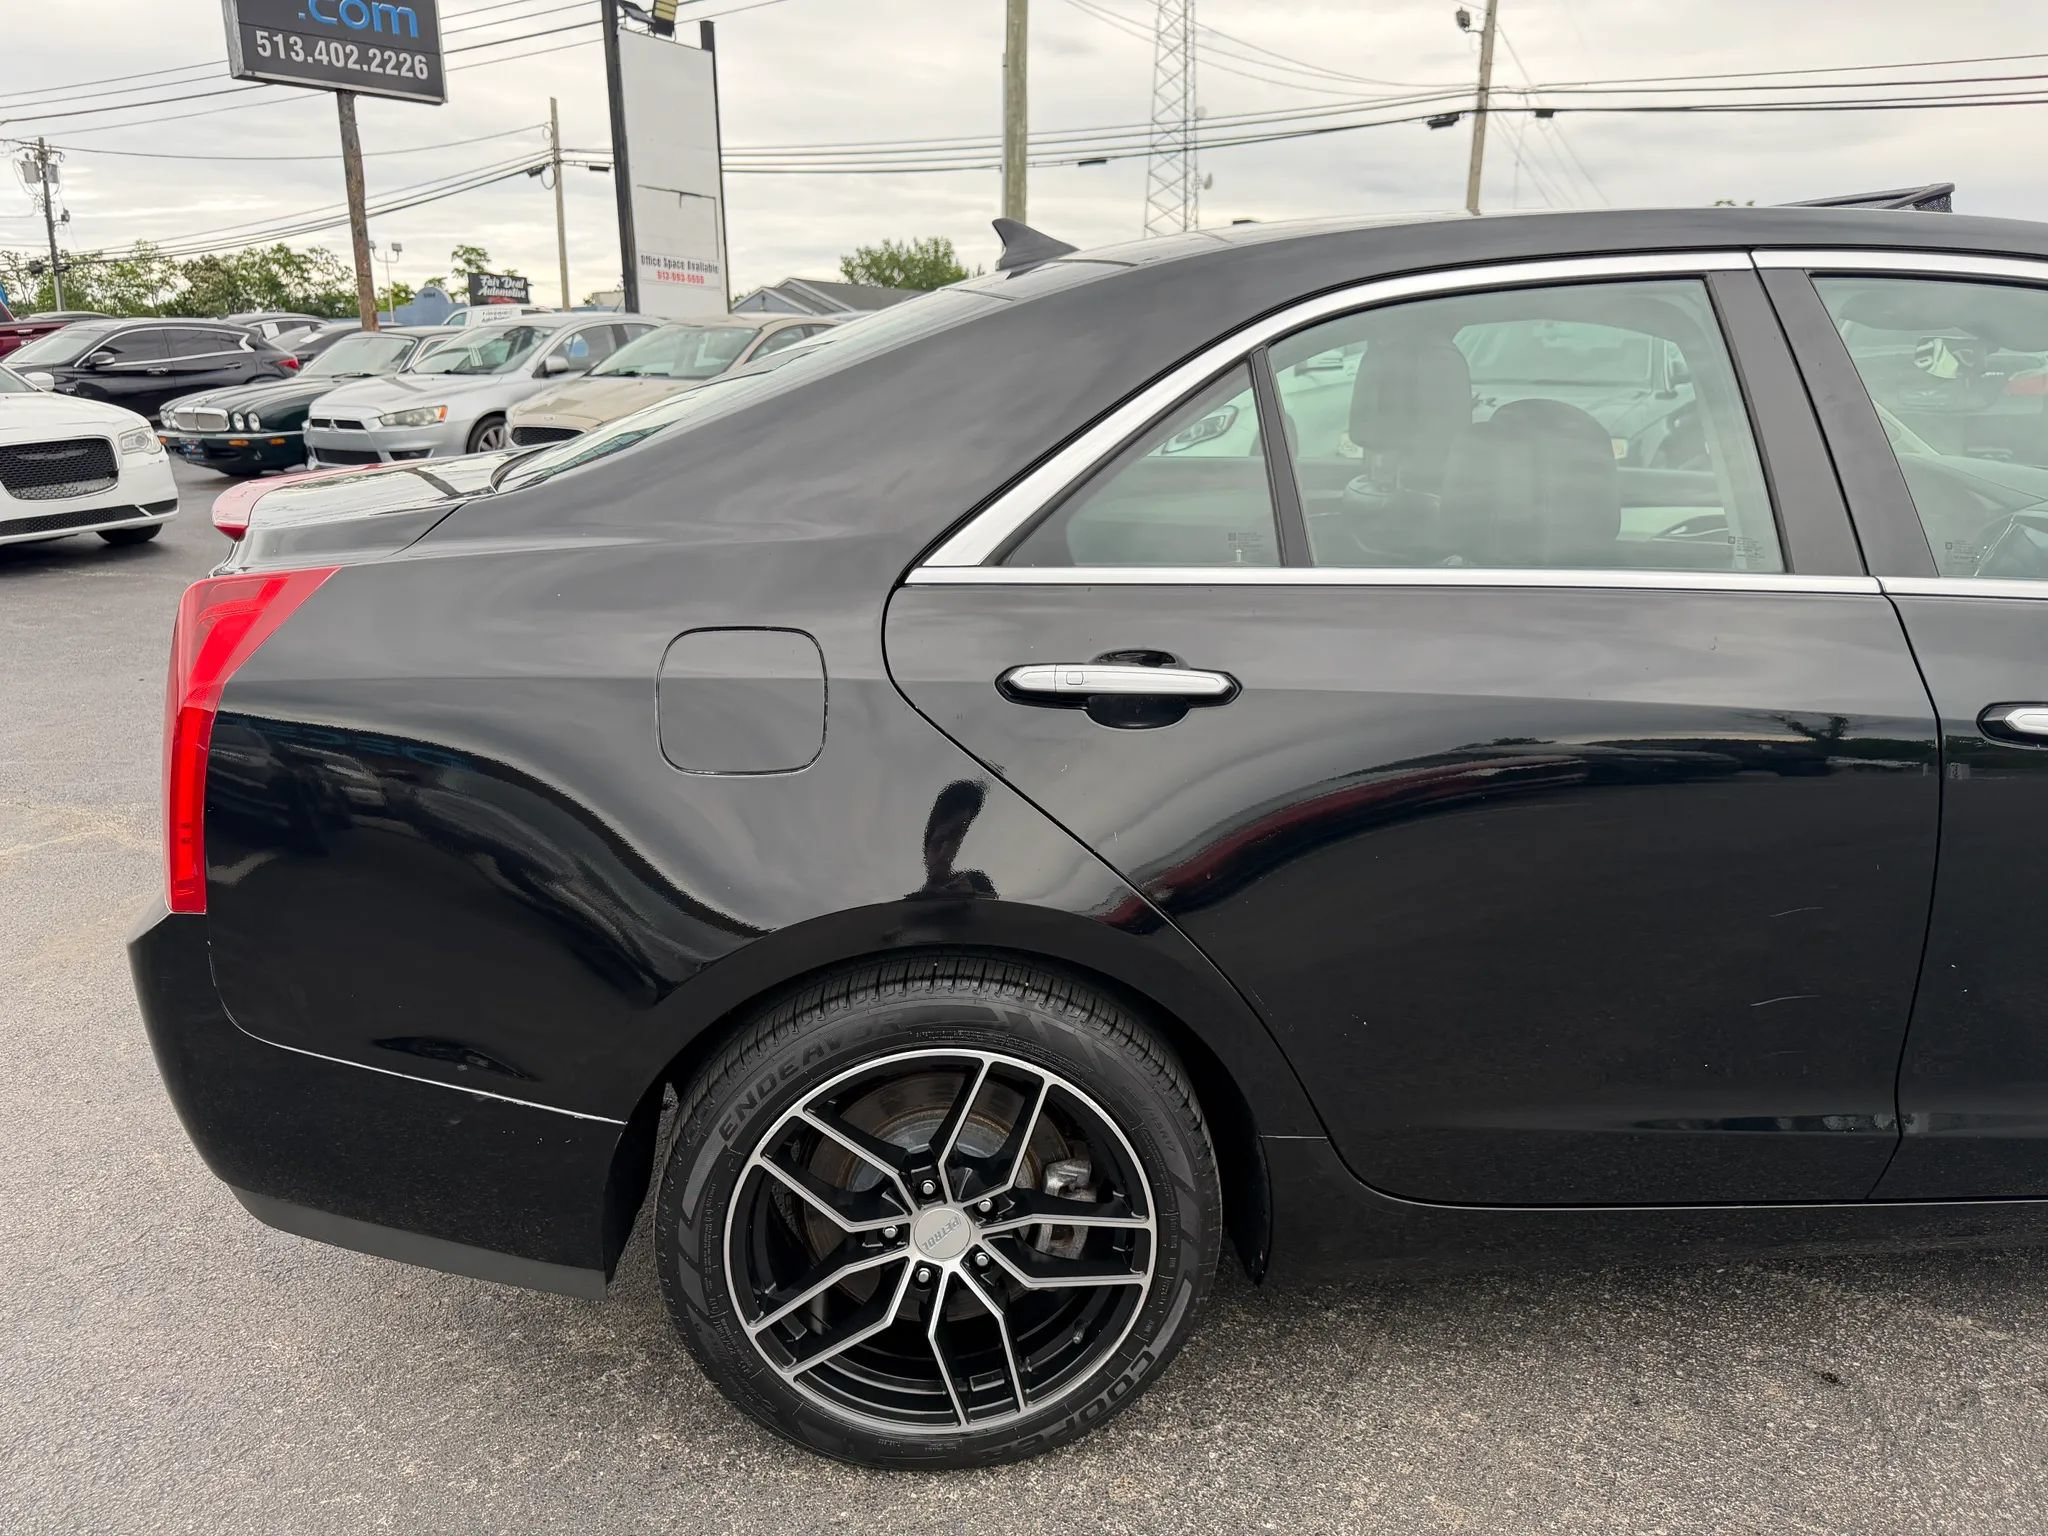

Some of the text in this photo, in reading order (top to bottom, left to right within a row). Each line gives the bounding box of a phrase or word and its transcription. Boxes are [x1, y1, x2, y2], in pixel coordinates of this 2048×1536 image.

[298, 0, 419, 38] .com
[255, 30, 428, 80] 513.402.2226
[641, 254, 719, 274] Office Space Available
[477, 286, 527, 298] Automotive
[480, 275, 525, 289] Fair Deal
[922, 1216, 961, 1251] PETROL
